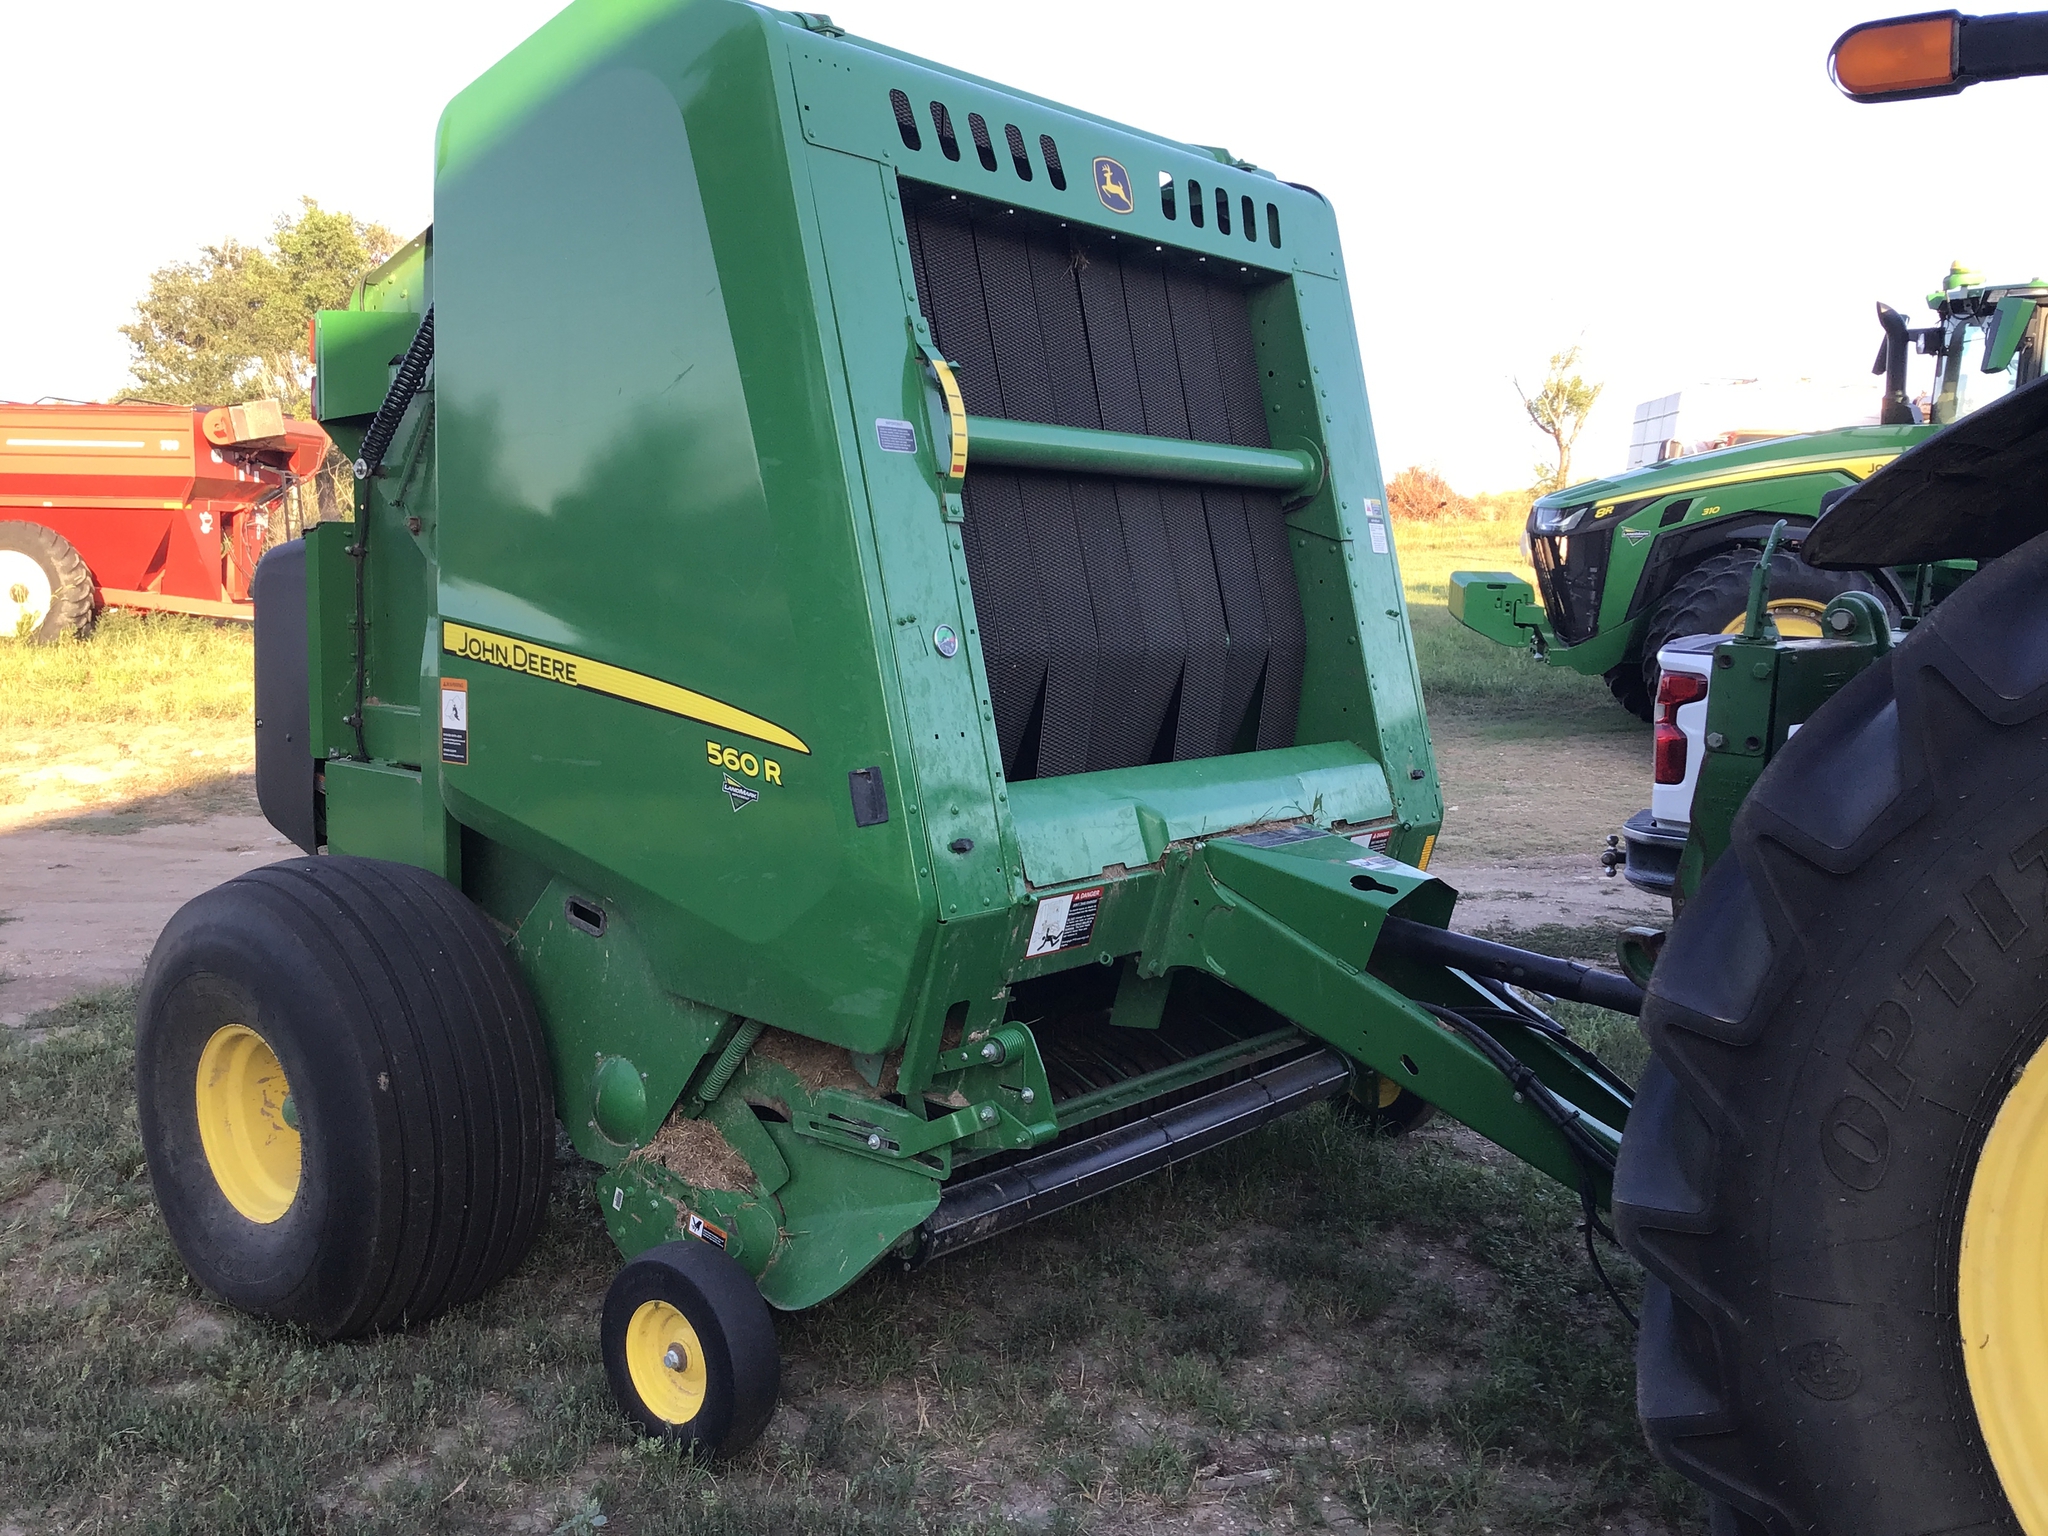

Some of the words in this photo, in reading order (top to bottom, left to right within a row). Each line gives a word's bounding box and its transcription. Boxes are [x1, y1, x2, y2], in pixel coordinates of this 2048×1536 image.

[1594, 505, 1615, 519] 8R
[1701, 506, 1720, 516] 310
[458, 632, 508, 664] JOHN
[513, 644, 577, 683] DEERE
[706, 739, 760, 778] 560
[763, 757, 784, 787] R
[1080, 889, 1101, 899] DANGER
